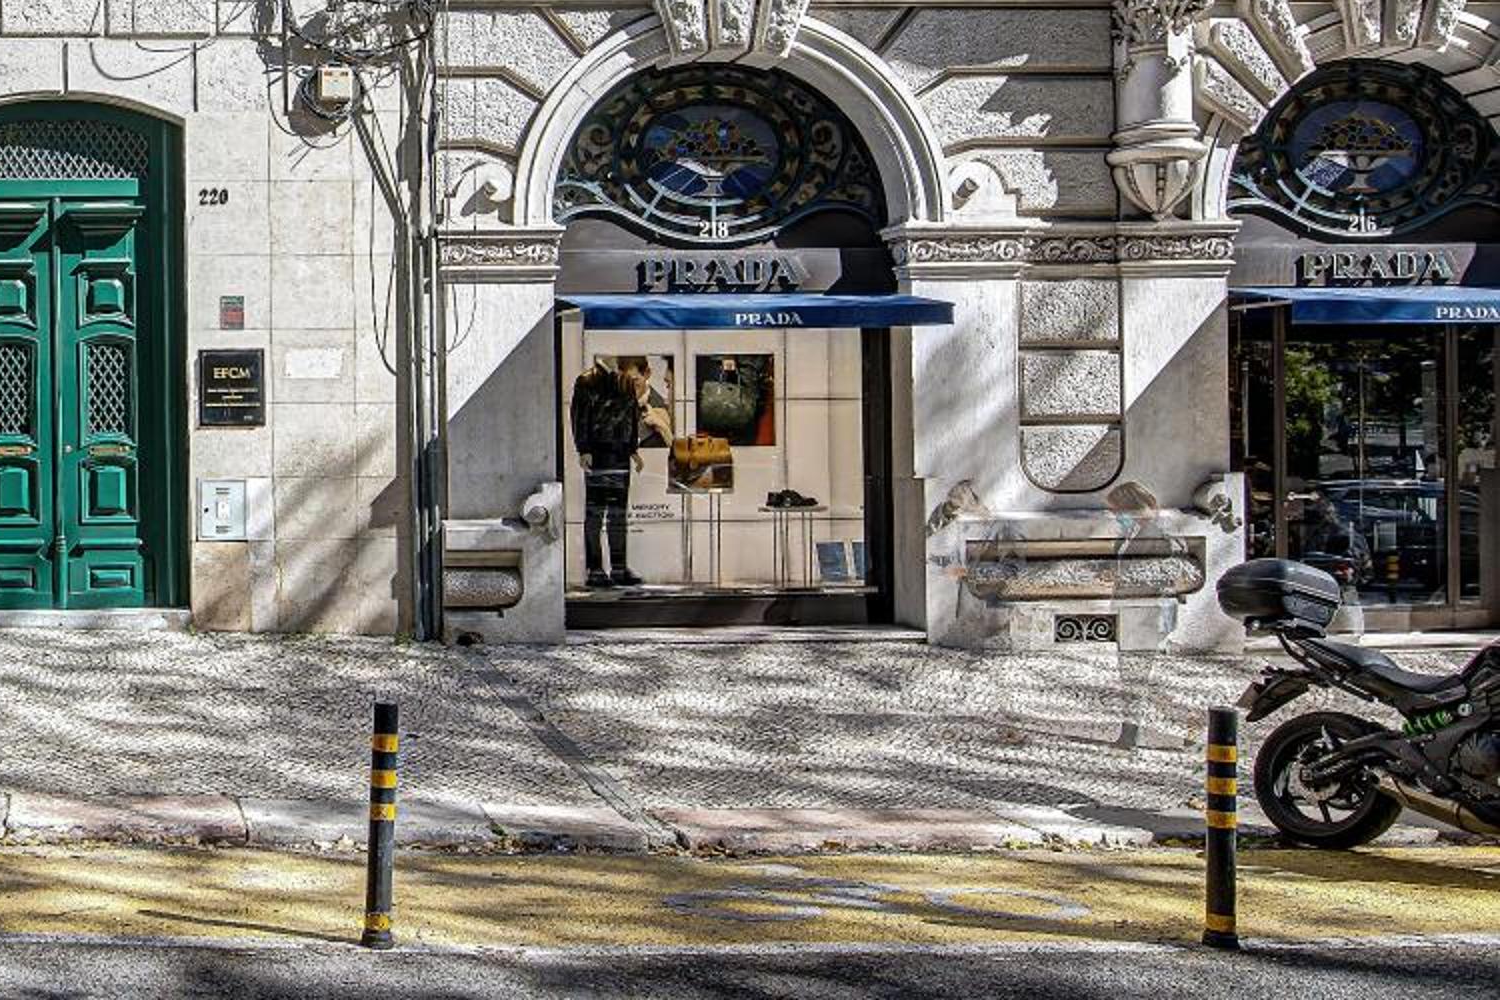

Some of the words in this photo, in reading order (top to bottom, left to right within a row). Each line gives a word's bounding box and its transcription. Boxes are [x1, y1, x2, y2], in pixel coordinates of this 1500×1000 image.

[198, 187, 229, 206] 220
[696, 221, 729, 239] 218
[1349, 215, 1377, 233] 216
[643, 256, 804, 286] PRADA
[1302, 251, 1457, 280] PRADA
[734, 311, 804, 326] PRADA
[1435, 306, 1500, 320] PRADA
